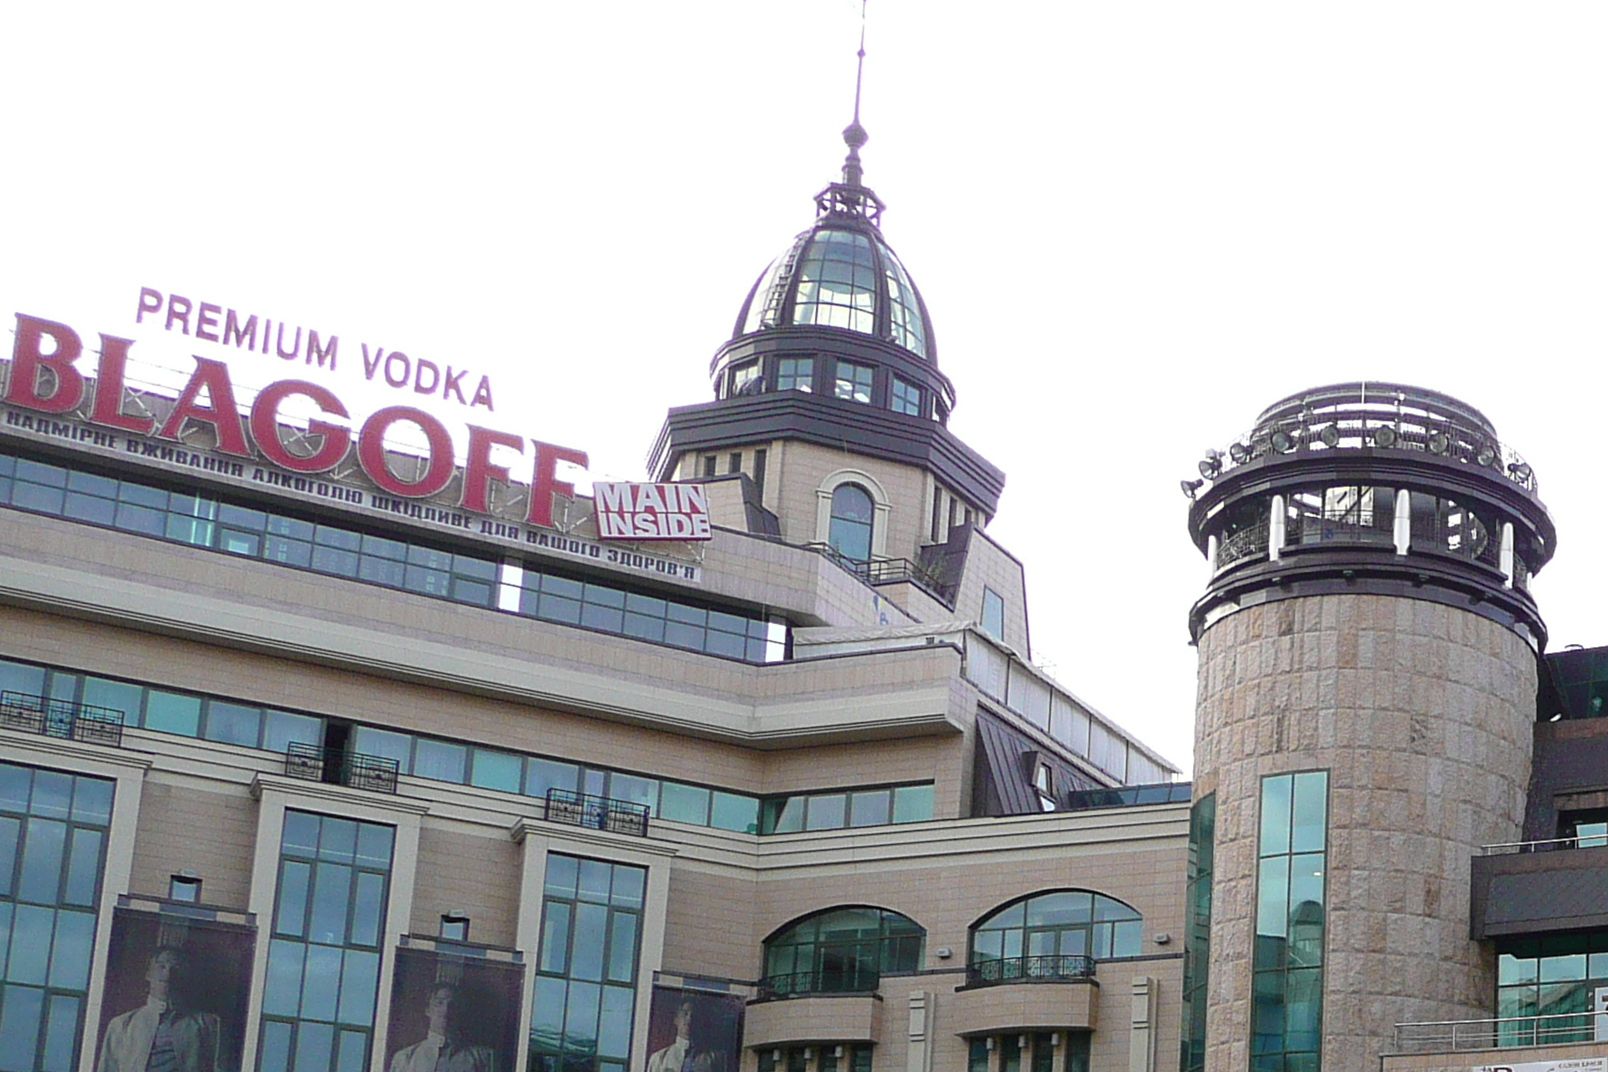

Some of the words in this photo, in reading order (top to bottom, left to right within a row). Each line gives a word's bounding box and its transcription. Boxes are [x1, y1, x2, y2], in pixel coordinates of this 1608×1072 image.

[136, 286, 338, 371] PREMIUM
[361, 342, 494, 412] VODKA
[4, 312, 590, 528] BLAGOFF
[6, 410, 117, 450] НАДМІРНЕ
[126, 438, 244, 478] ВЖИВАННЯ
[252, 467, 363, 504] АЛКОГОЛЮ
[371, 494, 472, 530] ШКІДЛИВЕ
[480, 519, 519, 540] ДЛЯ
[526, 529, 600, 559] ВАШОГО
[607, 549, 696, 580] ЗДОРОВ'Я
[599, 482, 707, 513] MAIN
[600, 512, 711, 538] INSIDE
